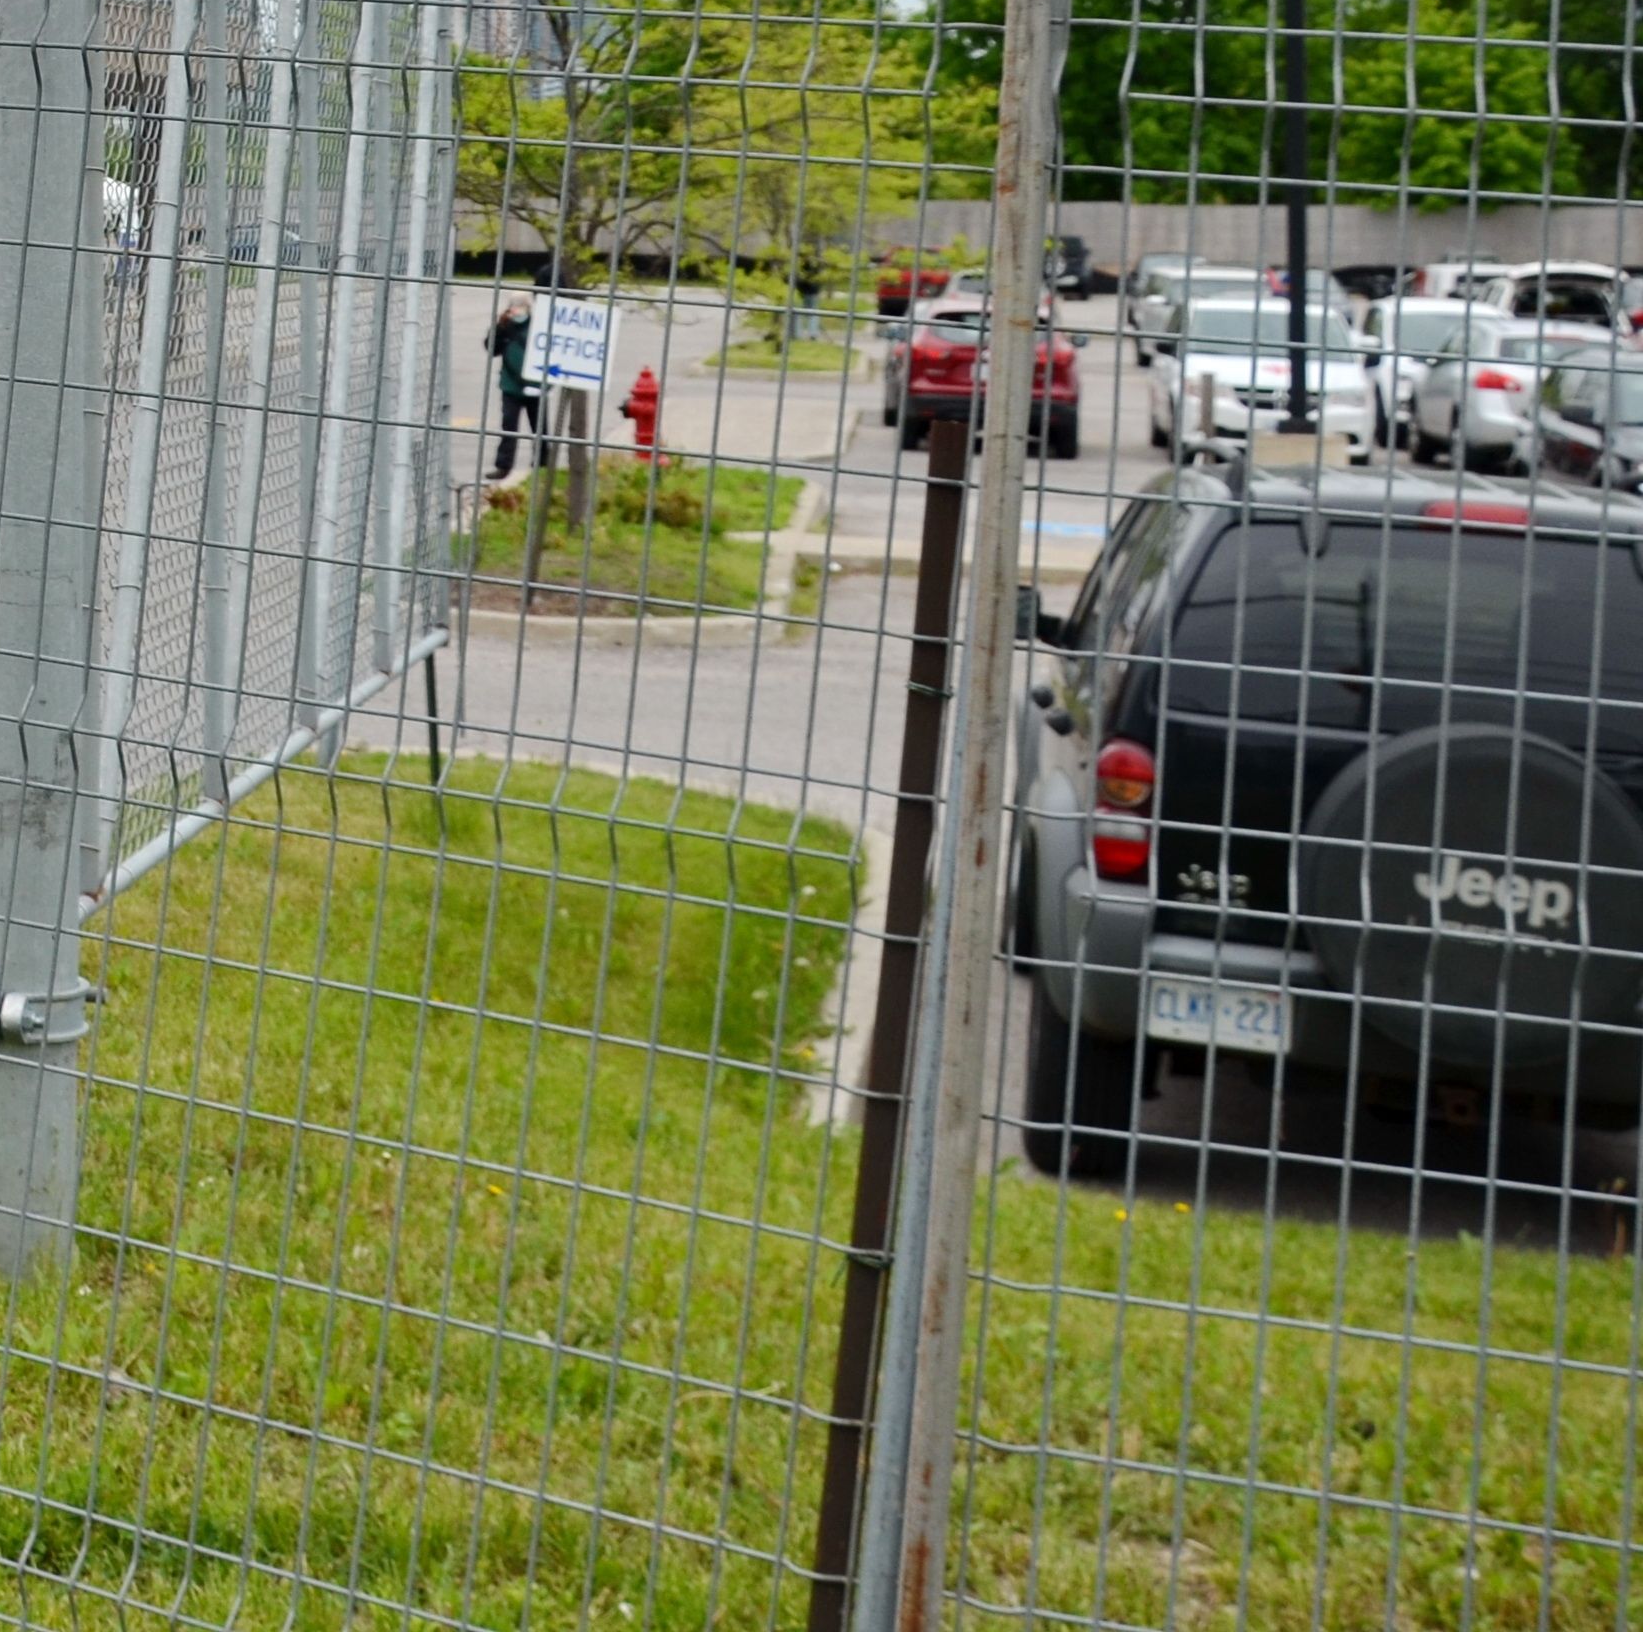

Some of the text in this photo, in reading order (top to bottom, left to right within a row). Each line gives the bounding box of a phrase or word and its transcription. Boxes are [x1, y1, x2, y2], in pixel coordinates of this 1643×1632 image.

[553, 305, 604, 330] MAIN
[535, 331, 606, 361] OFFICE
[1176, 863, 1251, 896] Jep
[1413, 854, 1574, 928] Jeep
